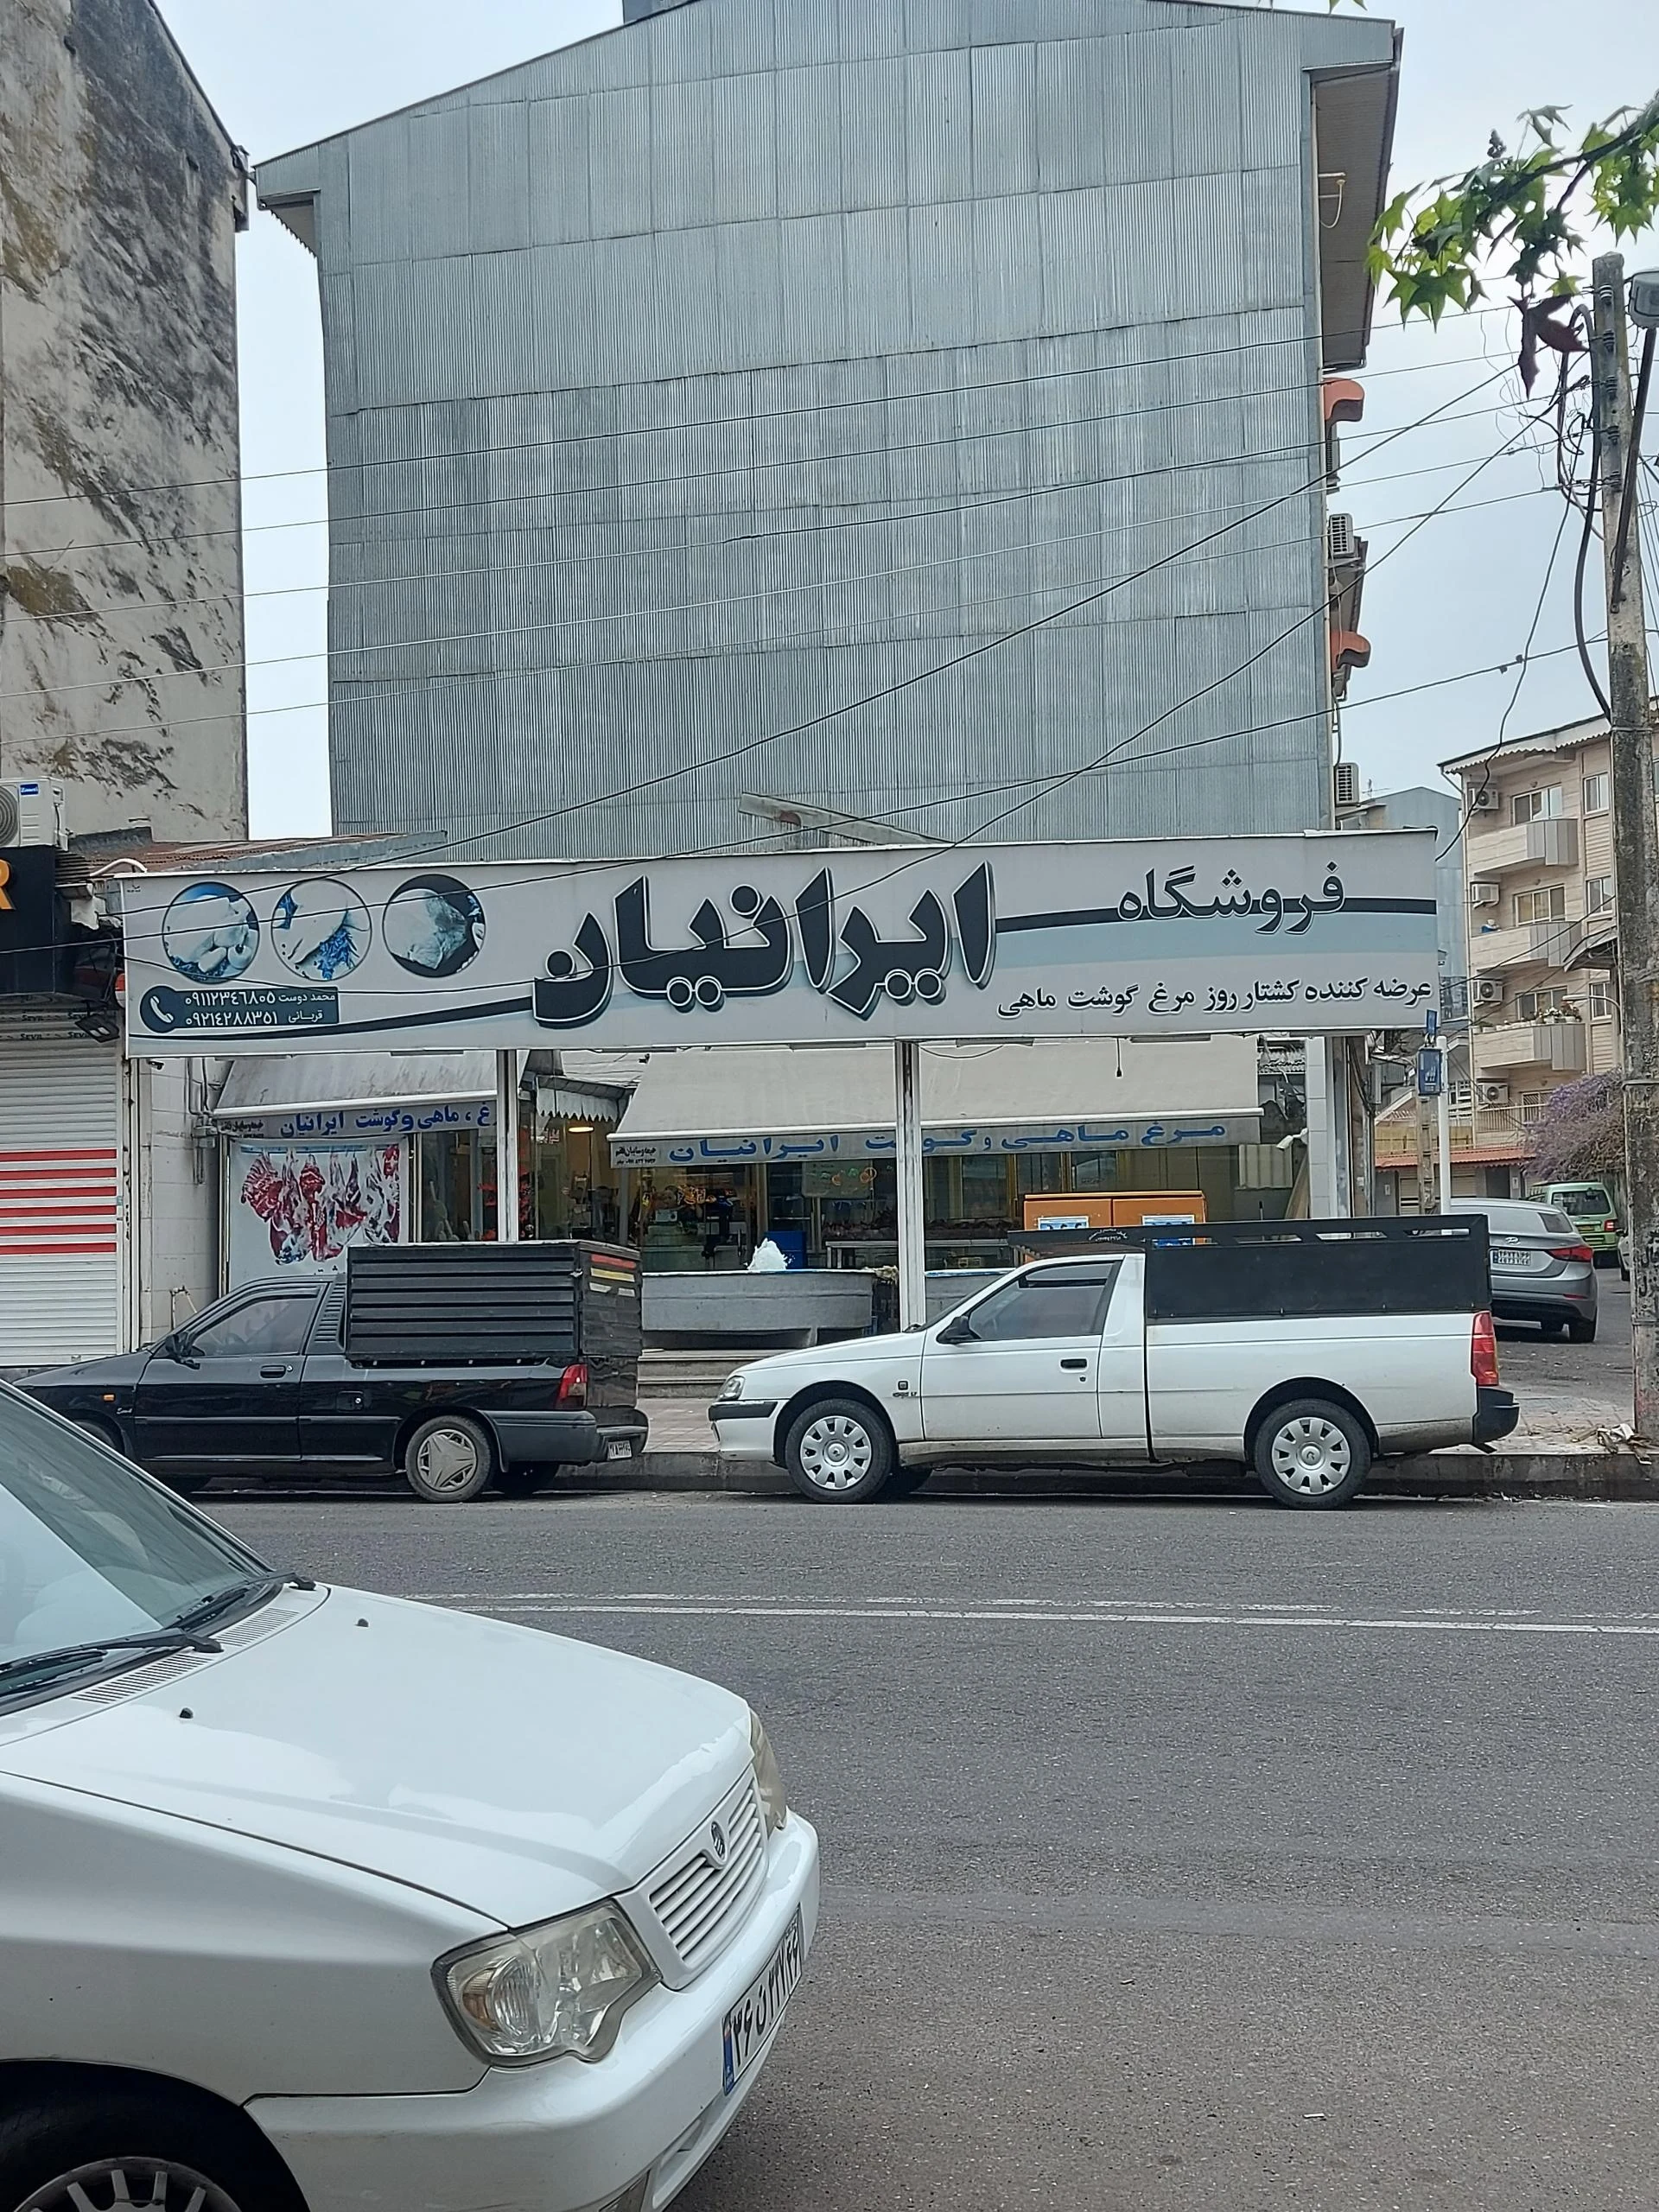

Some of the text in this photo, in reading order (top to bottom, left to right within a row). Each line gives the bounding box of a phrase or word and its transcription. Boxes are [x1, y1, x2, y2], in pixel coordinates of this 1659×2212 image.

[533, 861, 1345, 1029] فروشگاه ایرانیان
[278, 993, 308, 1005] دوست
[998, 977, 1432, 1019] عرضه کننده کشتار روز مرغ گوشت ماهی
[288, 1010, 323, 1023] قربانی
[280, 1111, 344, 1138] ایرانیان
[417, 1104, 459, 1129] ماهی
[982, 1135, 992, 1152] و
[1001, 1124, 1129, 1149] ماهی
[1141, 1122, 1226, 1146] مرغ
[669, 1135, 839, 1163] ایرانیان
